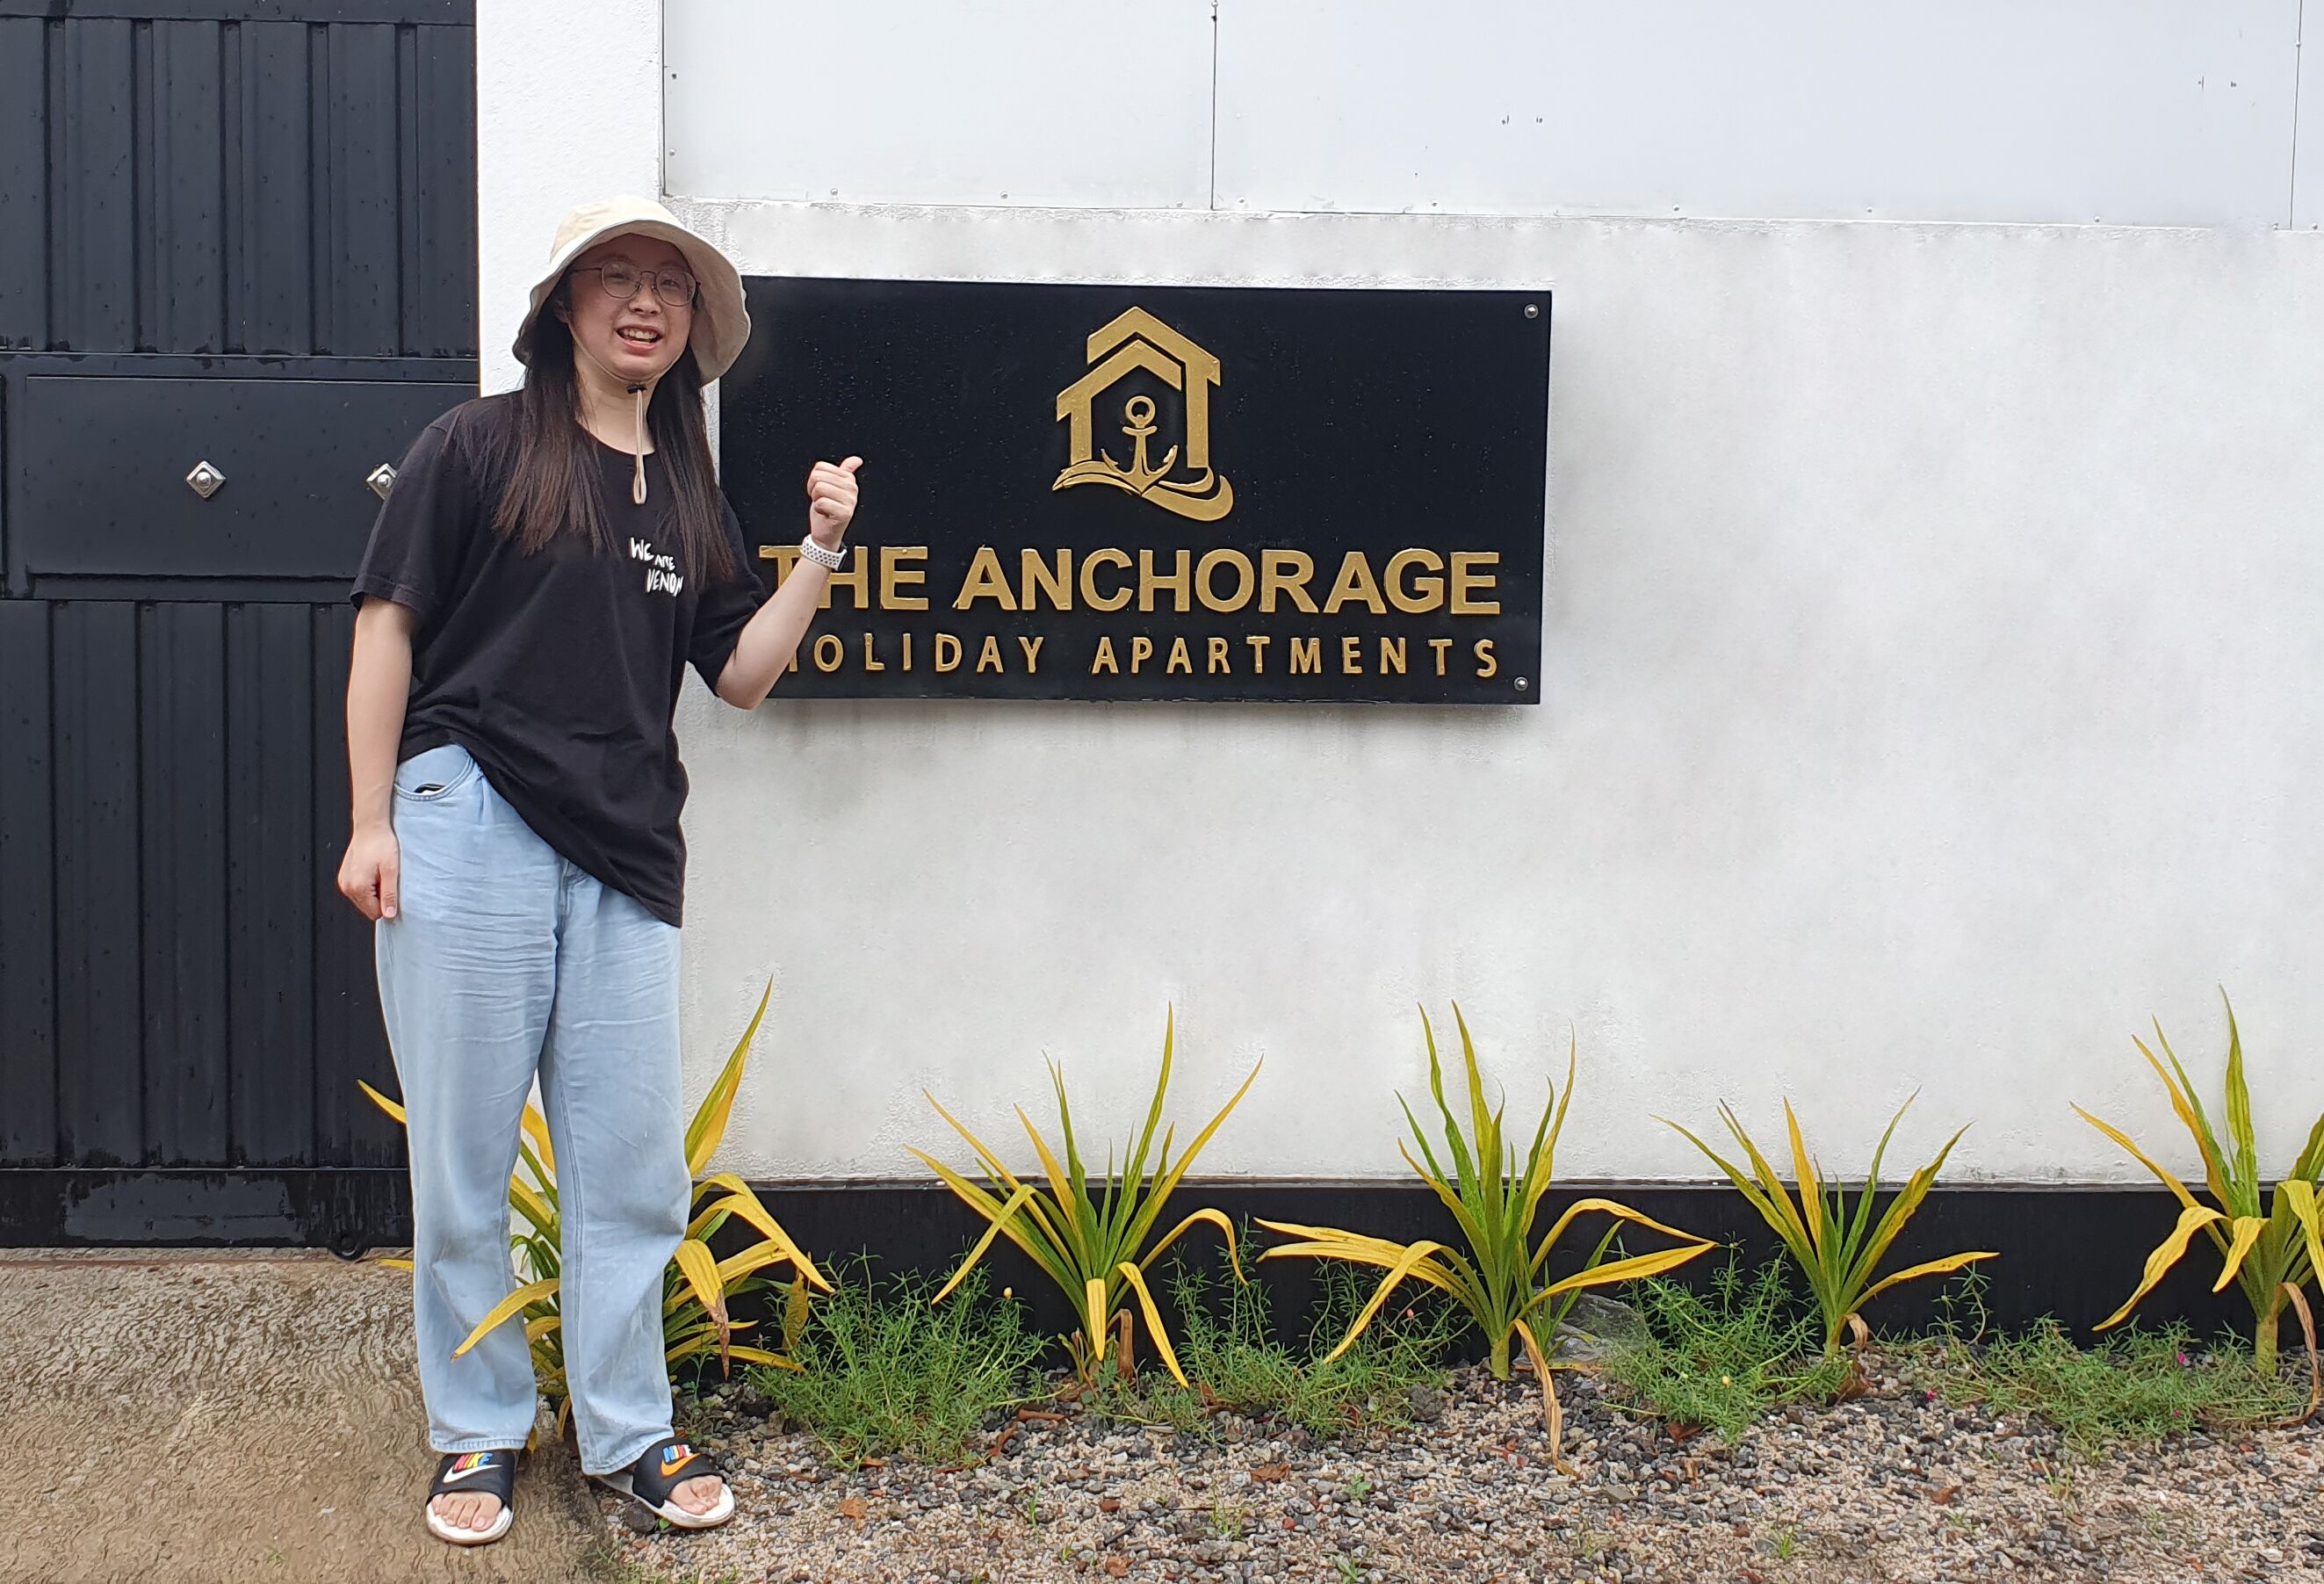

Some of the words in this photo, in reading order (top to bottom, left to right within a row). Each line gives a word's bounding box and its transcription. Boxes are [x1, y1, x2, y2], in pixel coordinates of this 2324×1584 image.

[631, 537, 654, 561] WE
[654, 554, 675, 571] ARE
[759, 545, 929, 611] THE
[952, 546, 1500, 614] ANCHORAGE
[789, 633, 1043, 674] OLIDAY
[1091, 635, 1498, 678] APARTMENTS
[453, 1452, 493, 1471] NIKE
[662, 1443, 694, 1463] NIKE
